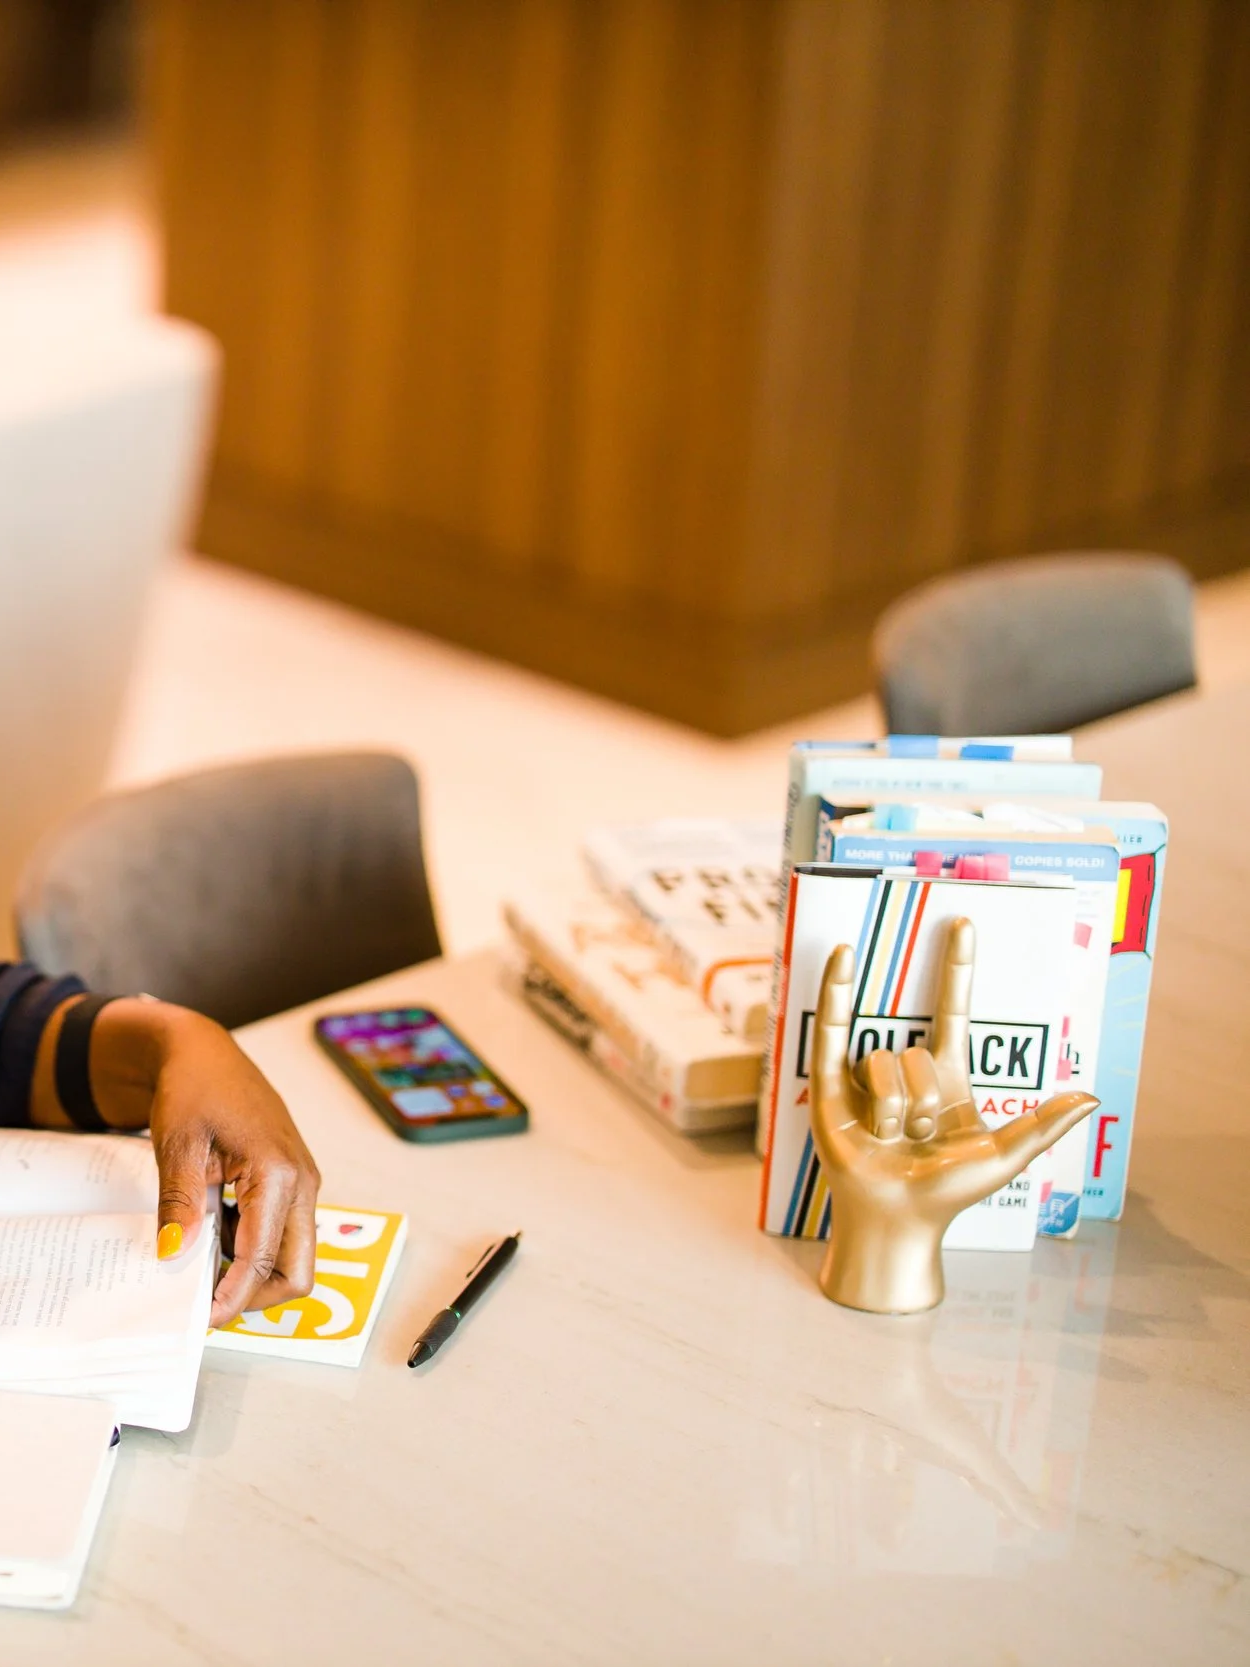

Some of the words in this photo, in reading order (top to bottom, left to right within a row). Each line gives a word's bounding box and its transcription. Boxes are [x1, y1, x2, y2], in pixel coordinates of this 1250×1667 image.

[844, 848, 884, 861] MORE
[1014, 854, 1062, 868] COPIES
[1065, 856, 1105, 868] SOLD!
